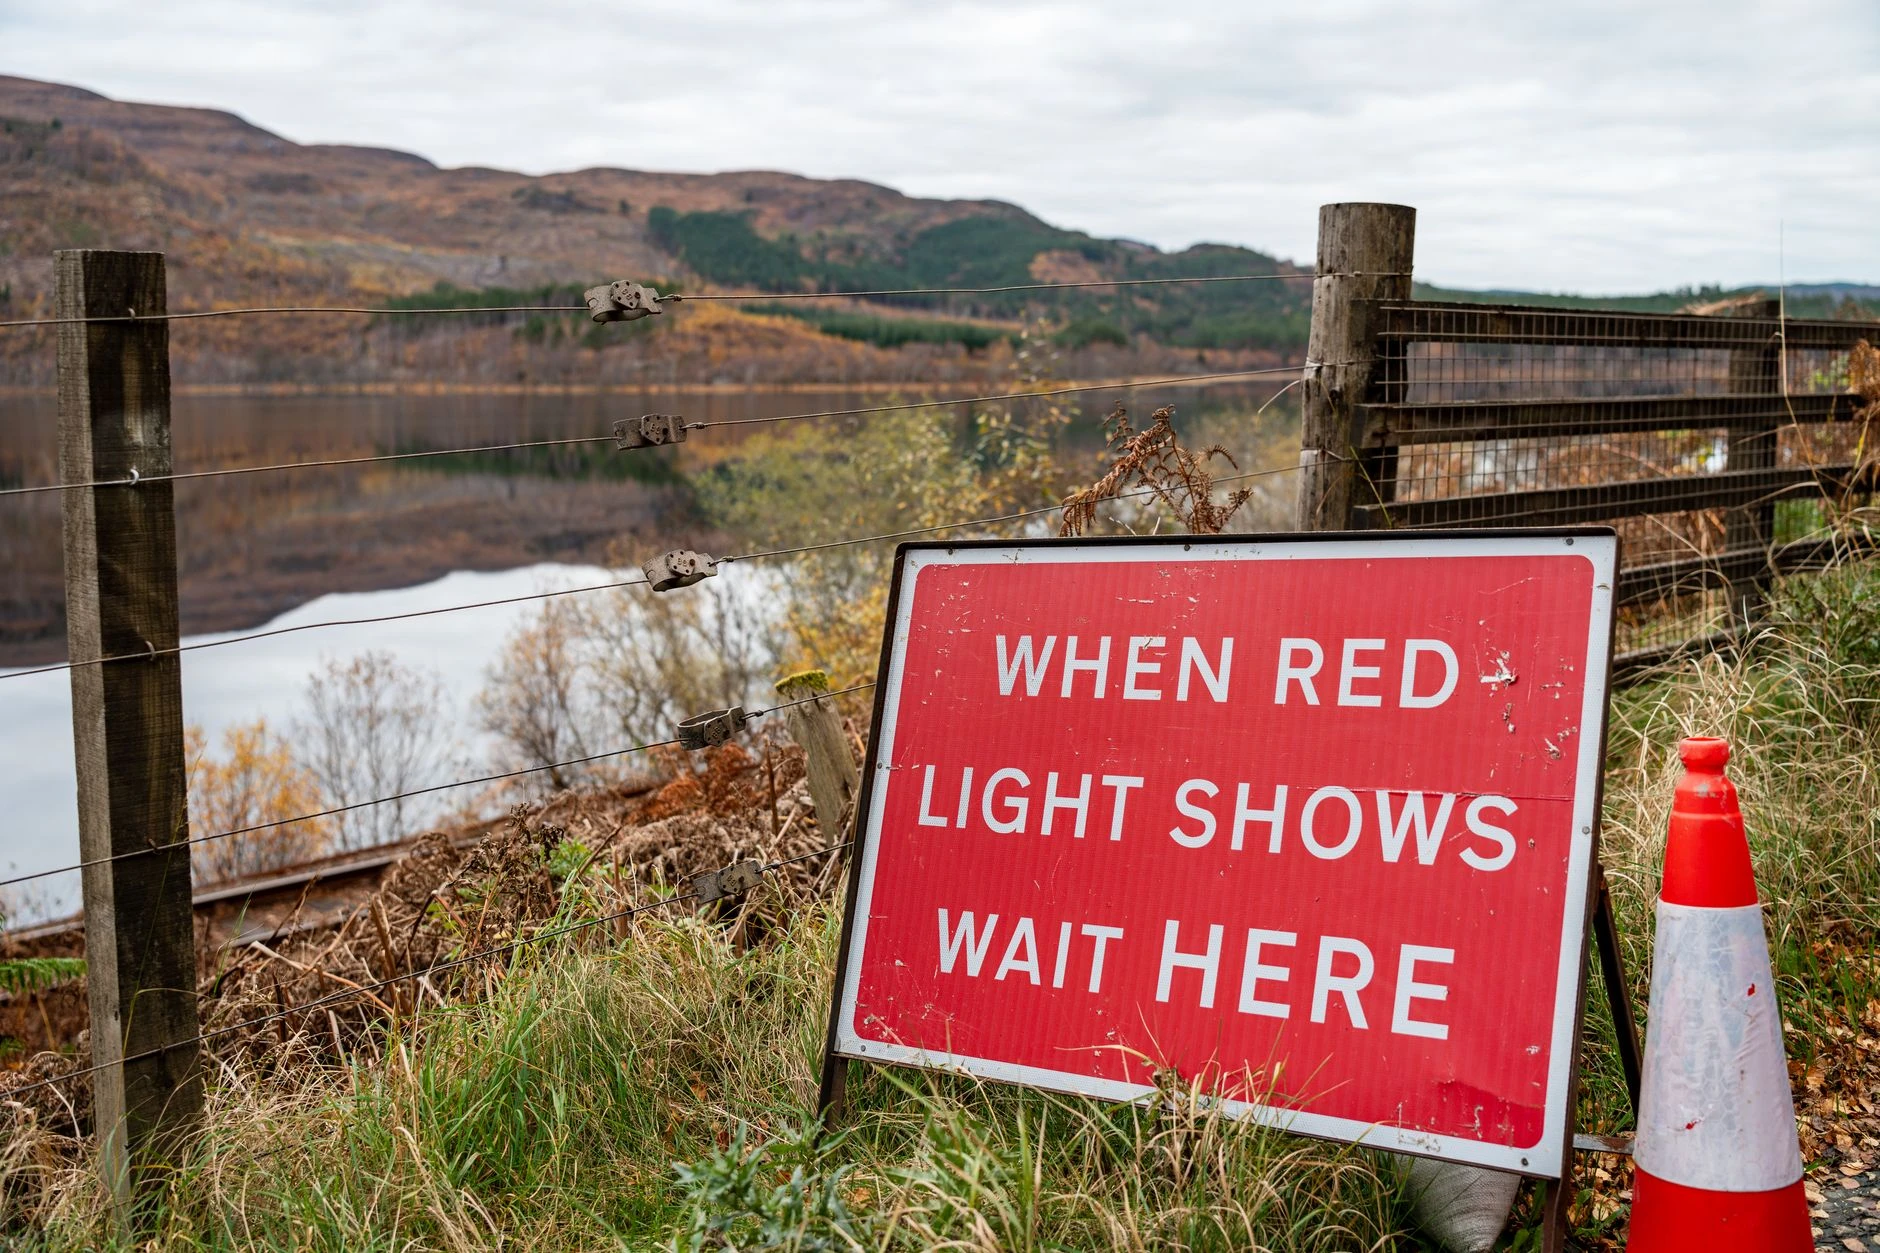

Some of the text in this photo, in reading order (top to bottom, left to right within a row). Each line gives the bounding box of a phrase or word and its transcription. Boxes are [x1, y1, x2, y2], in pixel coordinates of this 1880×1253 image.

[996, 634, 1460, 709] WHEN RED
[918, 765, 1519, 872] LIGHT SHOWS
[938, 908, 1456, 1041] WAIT HERE
